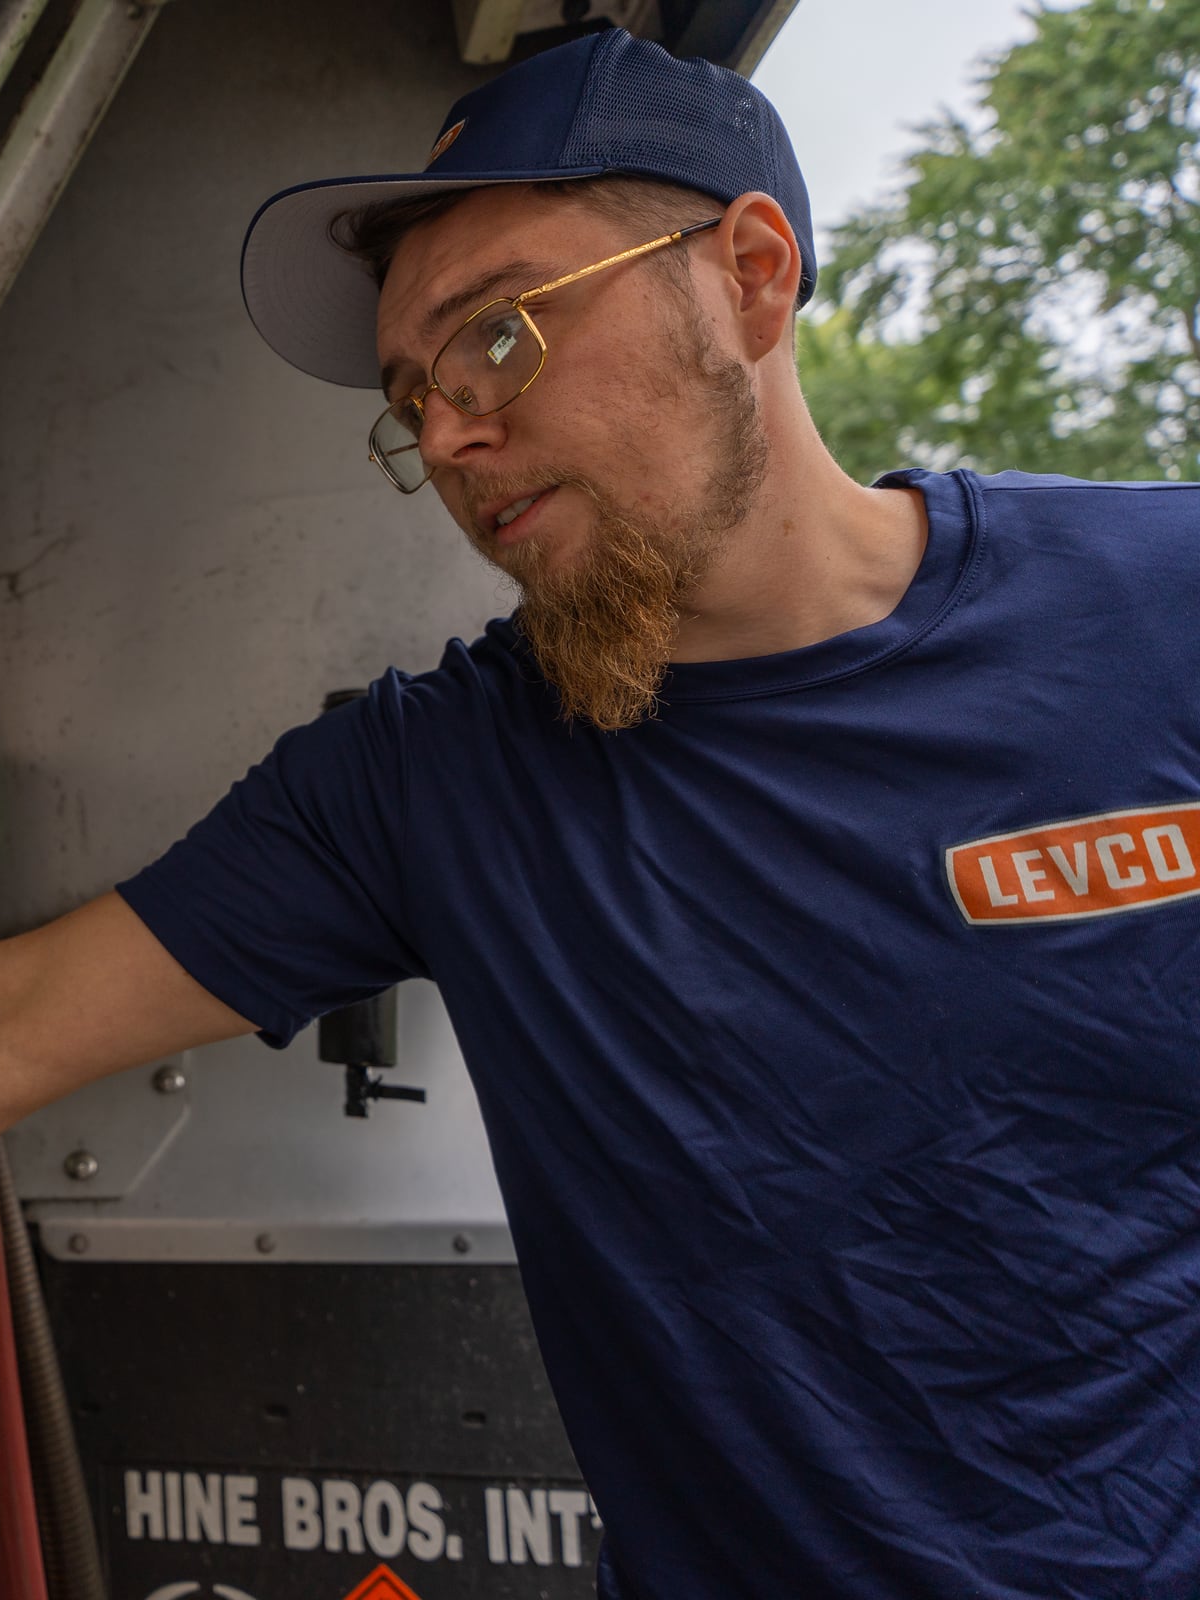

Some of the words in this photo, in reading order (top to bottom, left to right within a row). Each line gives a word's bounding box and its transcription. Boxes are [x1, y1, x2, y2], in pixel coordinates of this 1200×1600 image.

[978, 824, 1196, 907] LEVCO
[124, 1470, 261, 1545] HINE
[281, 1476, 464, 1562] BROS.
